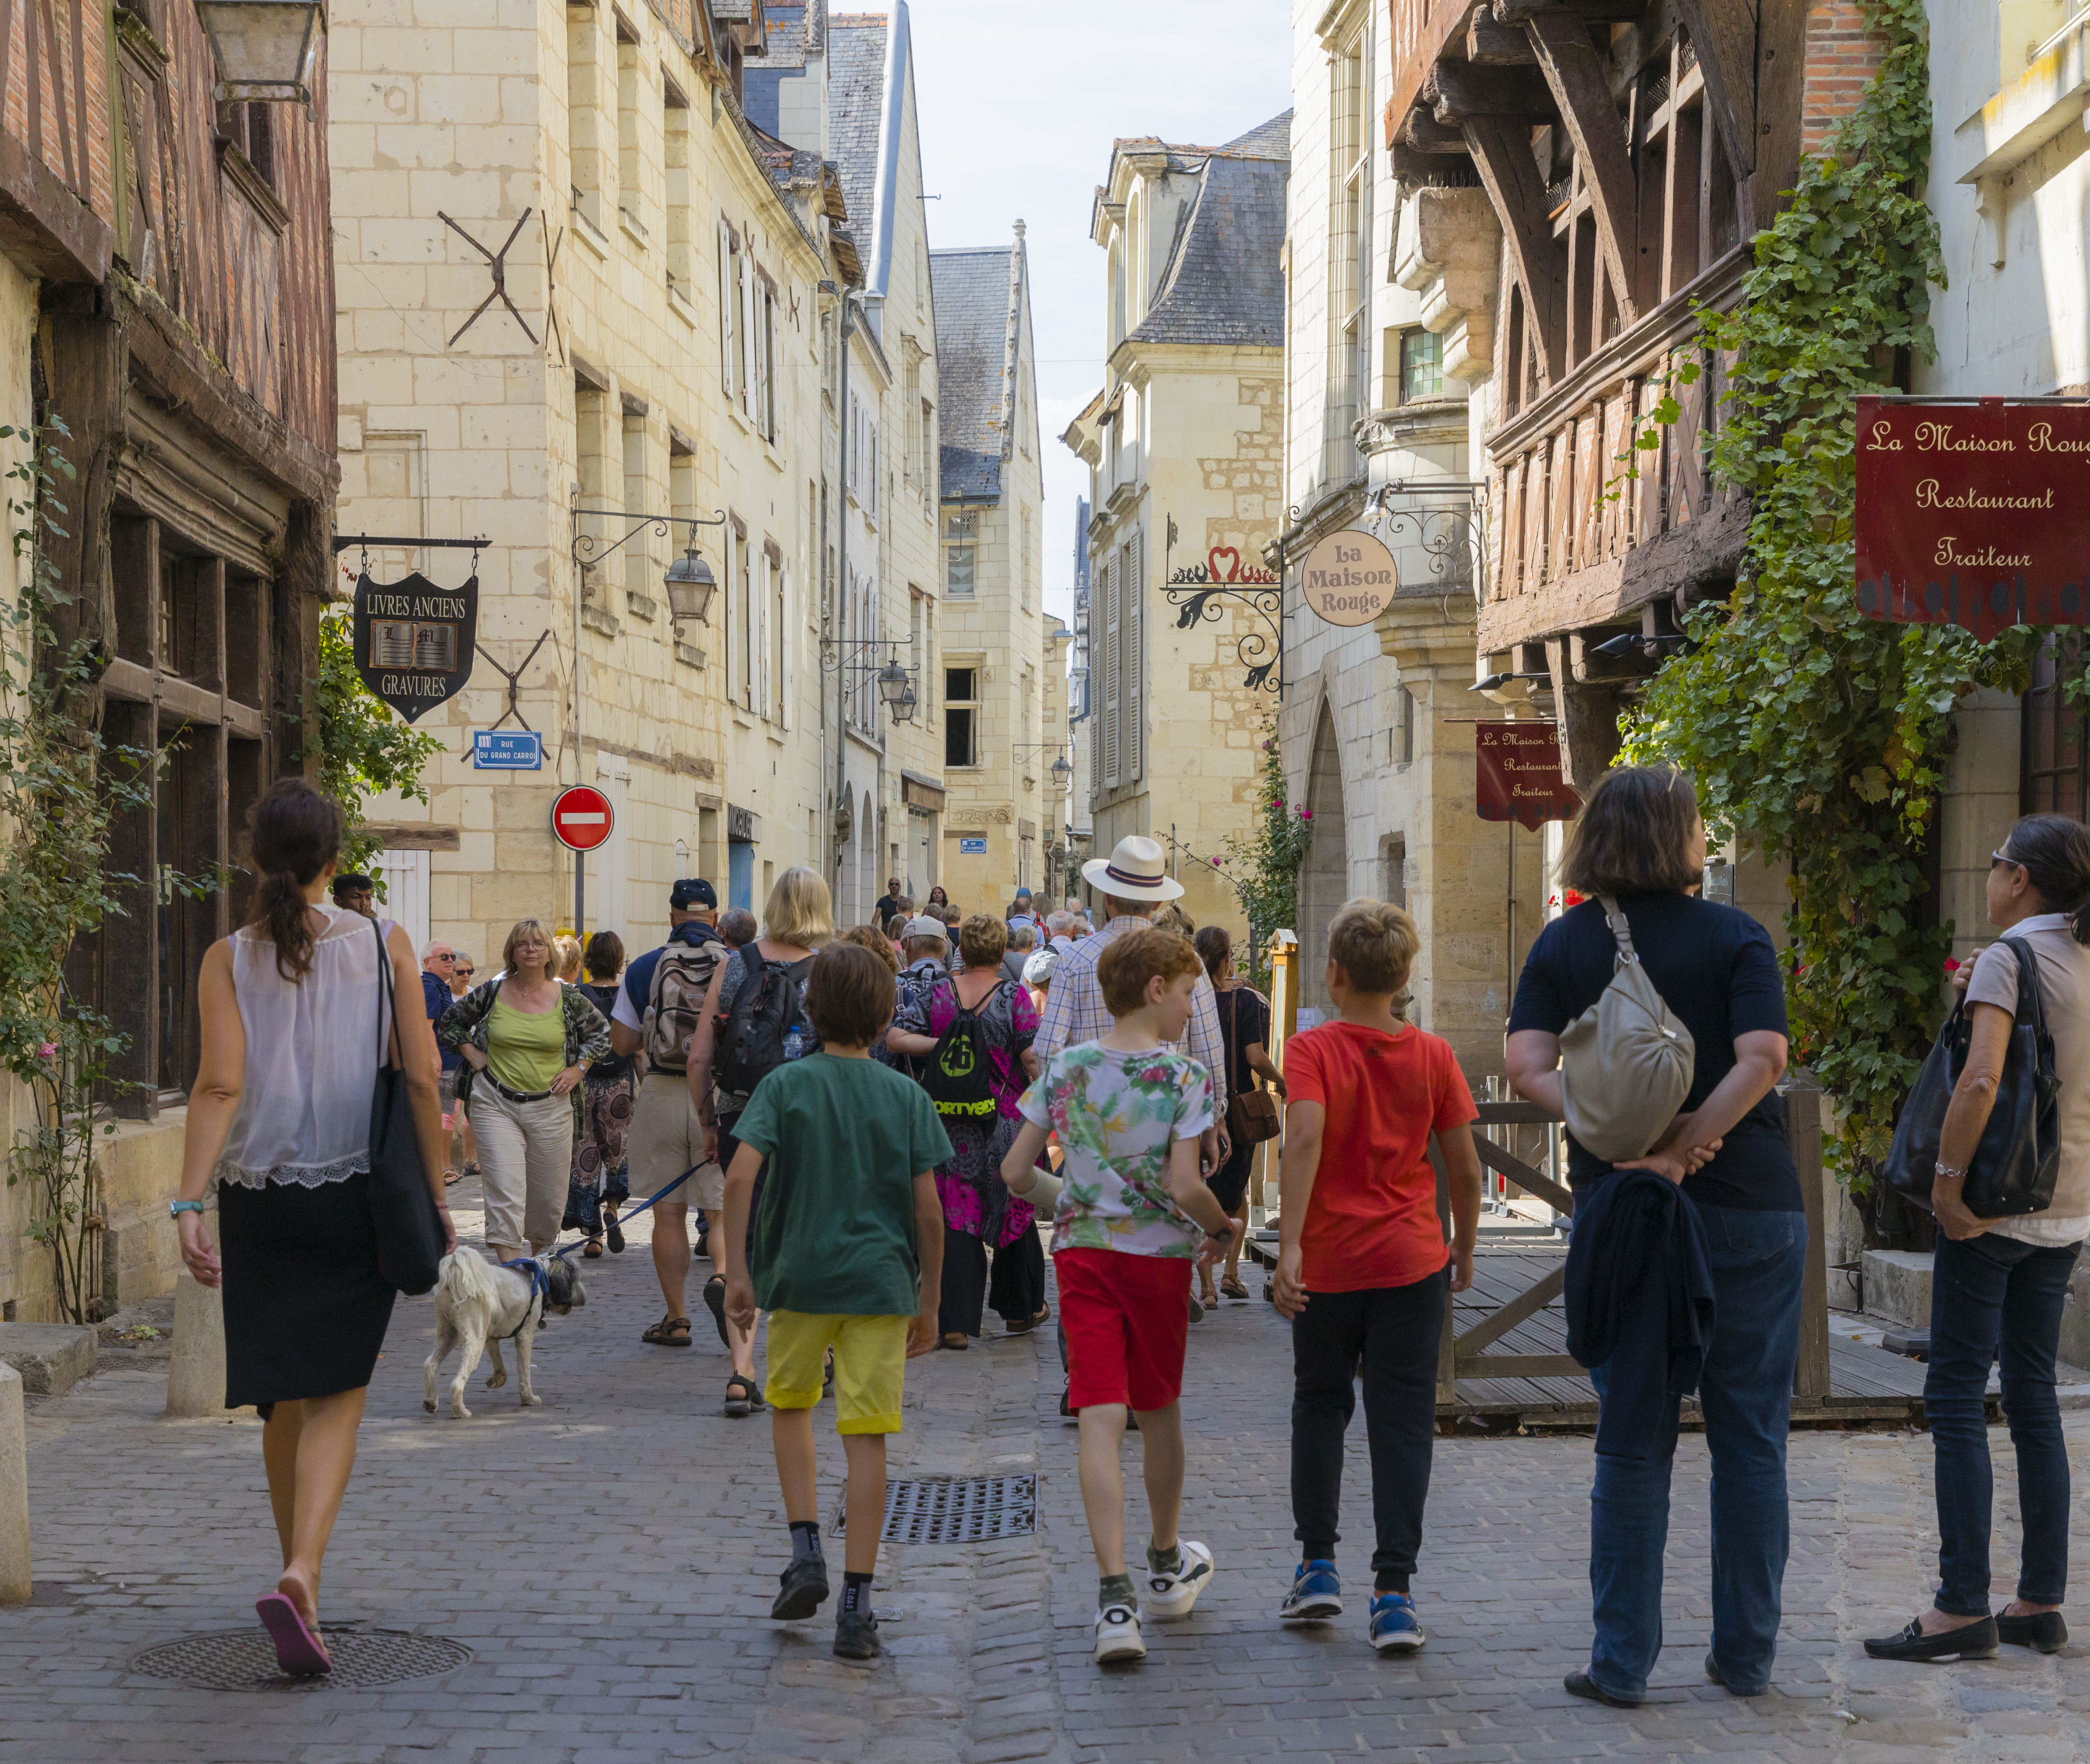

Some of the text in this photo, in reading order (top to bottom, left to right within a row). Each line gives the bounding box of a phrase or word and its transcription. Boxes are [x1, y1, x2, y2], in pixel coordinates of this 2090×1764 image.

[1866, 421, 2090, 464] La Maison Rou
[1916, 479, 2055, 508] Restaurant
[1335, 545, 1362, 563] La
[1934, 536, 2032, 566] Traiteur
[1308, 567, 1392, 588] Maison
[367, 594, 465, 619] LIVRES ANCIENS
[1321, 591, 1381, 614] Rouge
[382, 674, 445, 697] GRAVURES
[1482, 733, 1498, 745] La
[1502, 732, 1545, 745] Maison
[1504, 758, 1562, 771] Restaurant
[1512, 784, 1554, 797] Traiteur
[727, 802, 752, 840] MMOBILIER
[940, 1040, 971, 1070] 46
[933, 1098, 995, 1115] ORTYSIX
